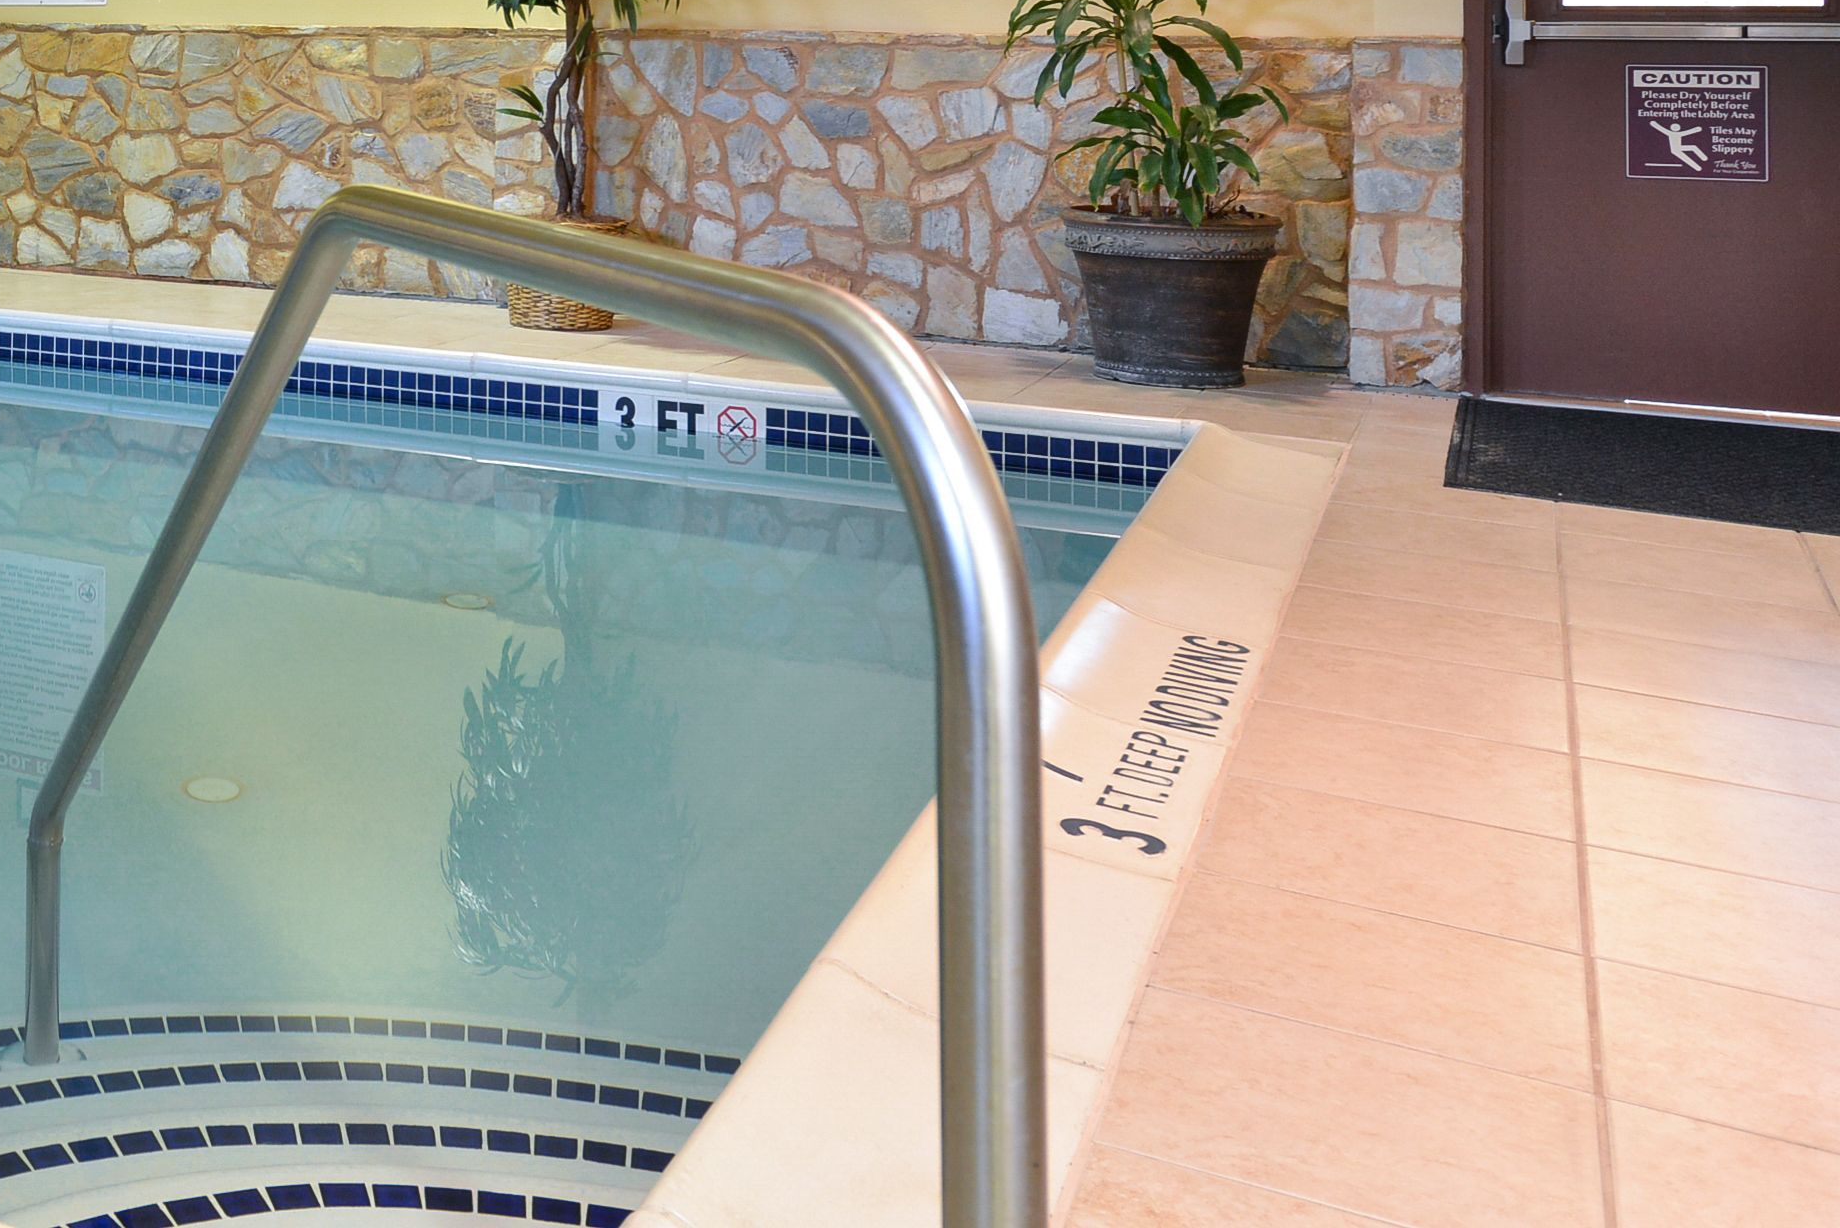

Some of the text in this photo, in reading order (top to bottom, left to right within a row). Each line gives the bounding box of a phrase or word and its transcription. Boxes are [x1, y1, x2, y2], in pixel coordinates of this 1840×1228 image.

[1641, 74, 1752, 85] CAUTION
[1641, 90, 1751, 101] Please Dry Yourself
[1644, 100, 1749, 110] Completely Before
[1638, 110, 1679, 119] Entering
[1680, 110, 1696, 118] the
[1698, 110, 1728, 120] Lobby
[1709, 126, 1757, 137] Tiles May
[1712, 136, 1754, 144] Become
[1712, 144, 1754, 155] Slippery
[1714, 159, 1757, 170] Thank You
[615, 396, 704, 436] 3 FT
[1155, 635, 1250, 706] DIVING
[1140, 700, 1223, 738] NO
[1113, 730, 1189, 787] DEEP
[1060, 818, 1166, 855] 3
